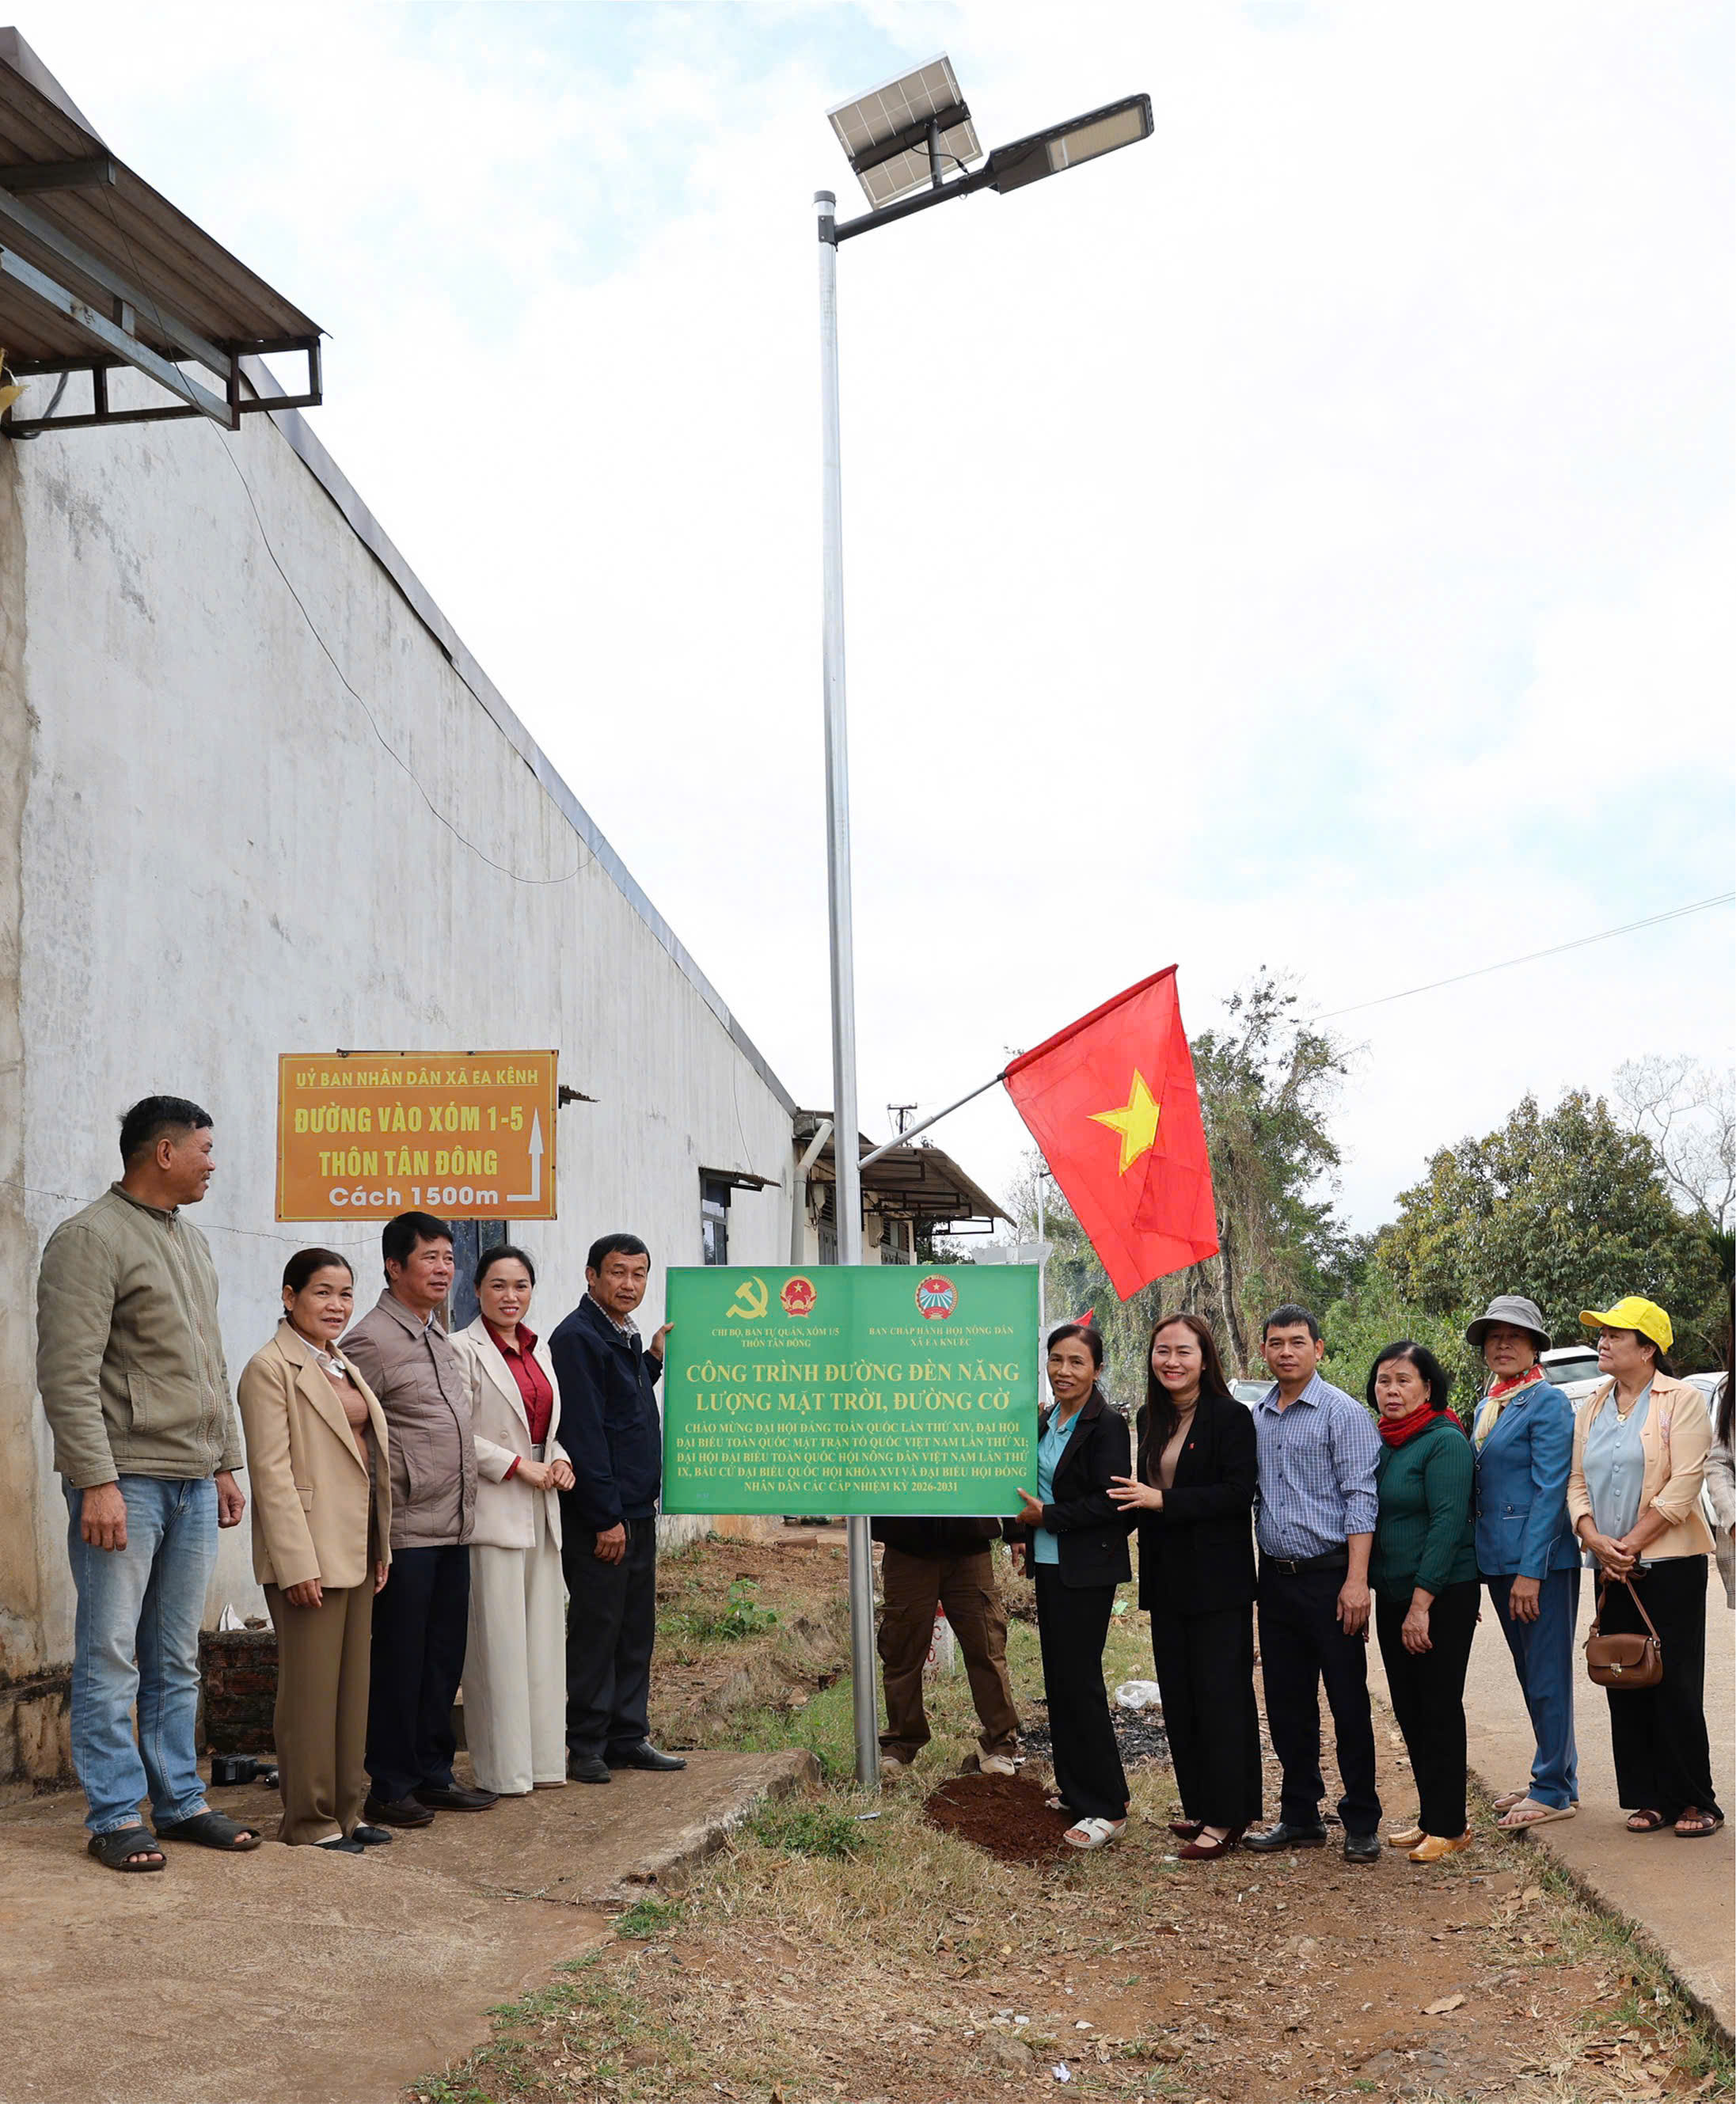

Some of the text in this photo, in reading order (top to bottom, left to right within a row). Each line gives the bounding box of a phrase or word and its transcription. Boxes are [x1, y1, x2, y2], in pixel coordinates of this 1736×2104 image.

[296, 1065, 538, 1087] UỶ BAN NHÂN DÂN XÃ EA KÊNH
[294, 1101, 523, 1134] ĐƯỜNG VÀO XÓM 1-5
[319, 1145, 498, 1176] THÔN TÂN ĐÔNG
[329, 1186, 499, 1206] Cách 1500m
[868, 1327, 887, 1335] BAN
[917, 1325, 943, 1335] HÀNH
[946, 1325, 963, 1336] HỘI
[966, 1325, 991, 1335] NÔNG
[994, 1325, 1013, 1335] DÂN
[741, 1338, 811, 1348] THÔN TÂN ĐÔNG
[910, 1336, 923, 1346] XÃ
[686, 1359, 1020, 1382] CÔNG TRÌNH ĐƯỜNG ĐÈN NĂNG
[696, 1388, 1010, 1415] LƯỢNG MẶT TRỜI, ĐƯỜNG CỜ
[685, 1421, 716, 1433] CHÀO
[719, 1420, 753, 1433] MỪNG
[755, 1423, 774, 1435] ĐẠI
[777, 1422, 797, 1435] HỘI
[800, 1421, 831, 1433] ĐẢNG
[835, 1421, 863, 1432] TOÀN
[867, 1421, 898, 1434] QUỐC
[901, 1420, 925, 1432] LẦN
[926, 1421, 952, 1432] THỨ
[976, 1422, 996, 1434] ĐẠI
[999, 1422, 1020, 1434] HỘI
[676, 1437, 696, 1450] ĐẠI
[698, 1436, 724, 1447] BIỂU
[726, 1435, 756, 1447] TOÀN
[758, 1435, 790, 1449] QUỐC
[793, 1436, 818, 1449] MẶT
[819, 1435, 849, 1449] TRẬN
[870, 1435, 901, 1449] QUỐC
[905, 1435, 930, 1449] VIỆT
[933, 1437, 958, 1447] NAM
[962, 1433, 984, 1447] LẦN
[987, 1434, 1012, 1447] THỨ
[677, 1450, 1029, 1464] ĐẠI HỘI ĐẠI BIỂU TOÀN QUỐC HỘI NÔNG DÂN VIỆT NAM LẦN THỨ
[678, 1464, 1027, 1479] IX, BẦU CỬ ĐẠI BIỂU QUỐC HỘI KHÓA XVI VÀ ĐẠI BIỂU HỘI ĐỒNG
[744, 1479, 958, 1494] NHÂN DÂN CÁC CẤP NHIỆM KỲ 2026-2031
